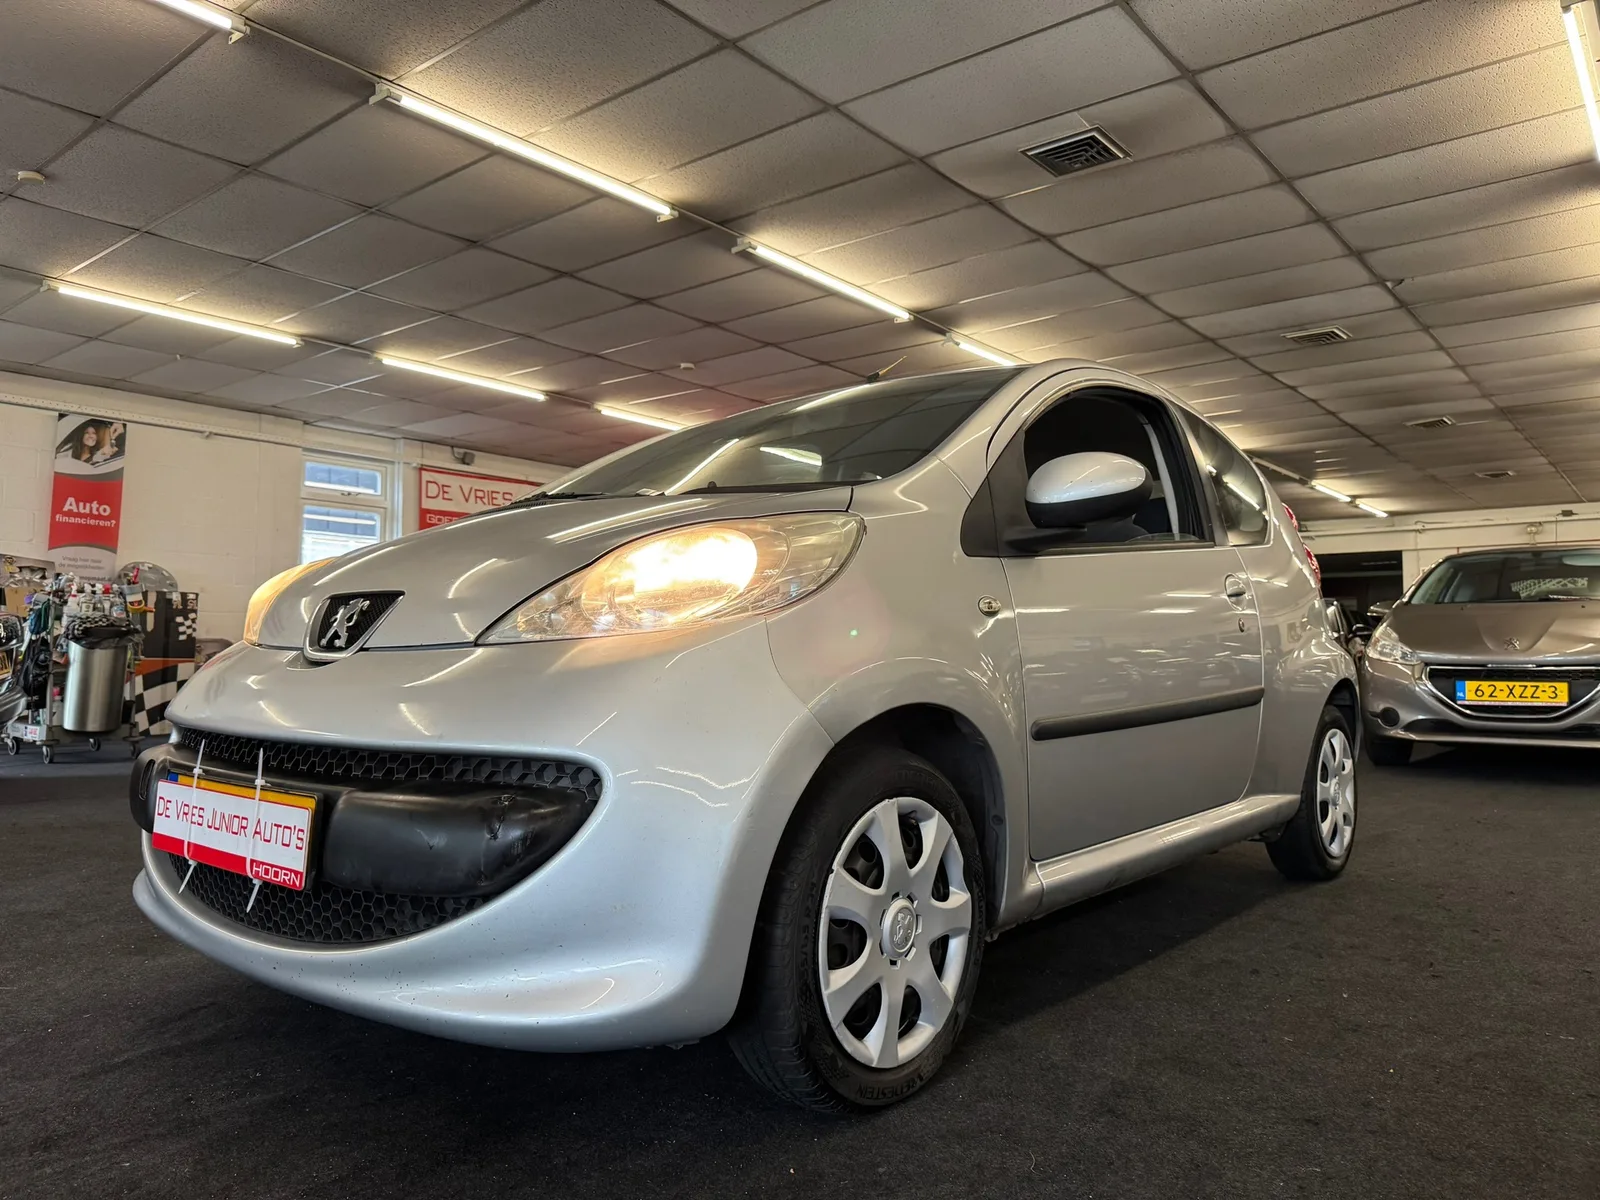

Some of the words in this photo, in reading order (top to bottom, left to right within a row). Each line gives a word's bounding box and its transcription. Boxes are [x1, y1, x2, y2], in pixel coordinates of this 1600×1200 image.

[425, 480, 453, 501] DE
[460, 485, 513, 506] VRIES
[62, 497, 111, 516] Auto
[55, 513, 116, 528] financieren?
[1474, 684, 1558, 699] 62-XZZ-3
[157, 796, 172, 818] DE
[207, 807, 248, 837] JUNIOR
[252, 817, 305, 851] AUTO'S
[252, 862, 301, 888] HOORN
